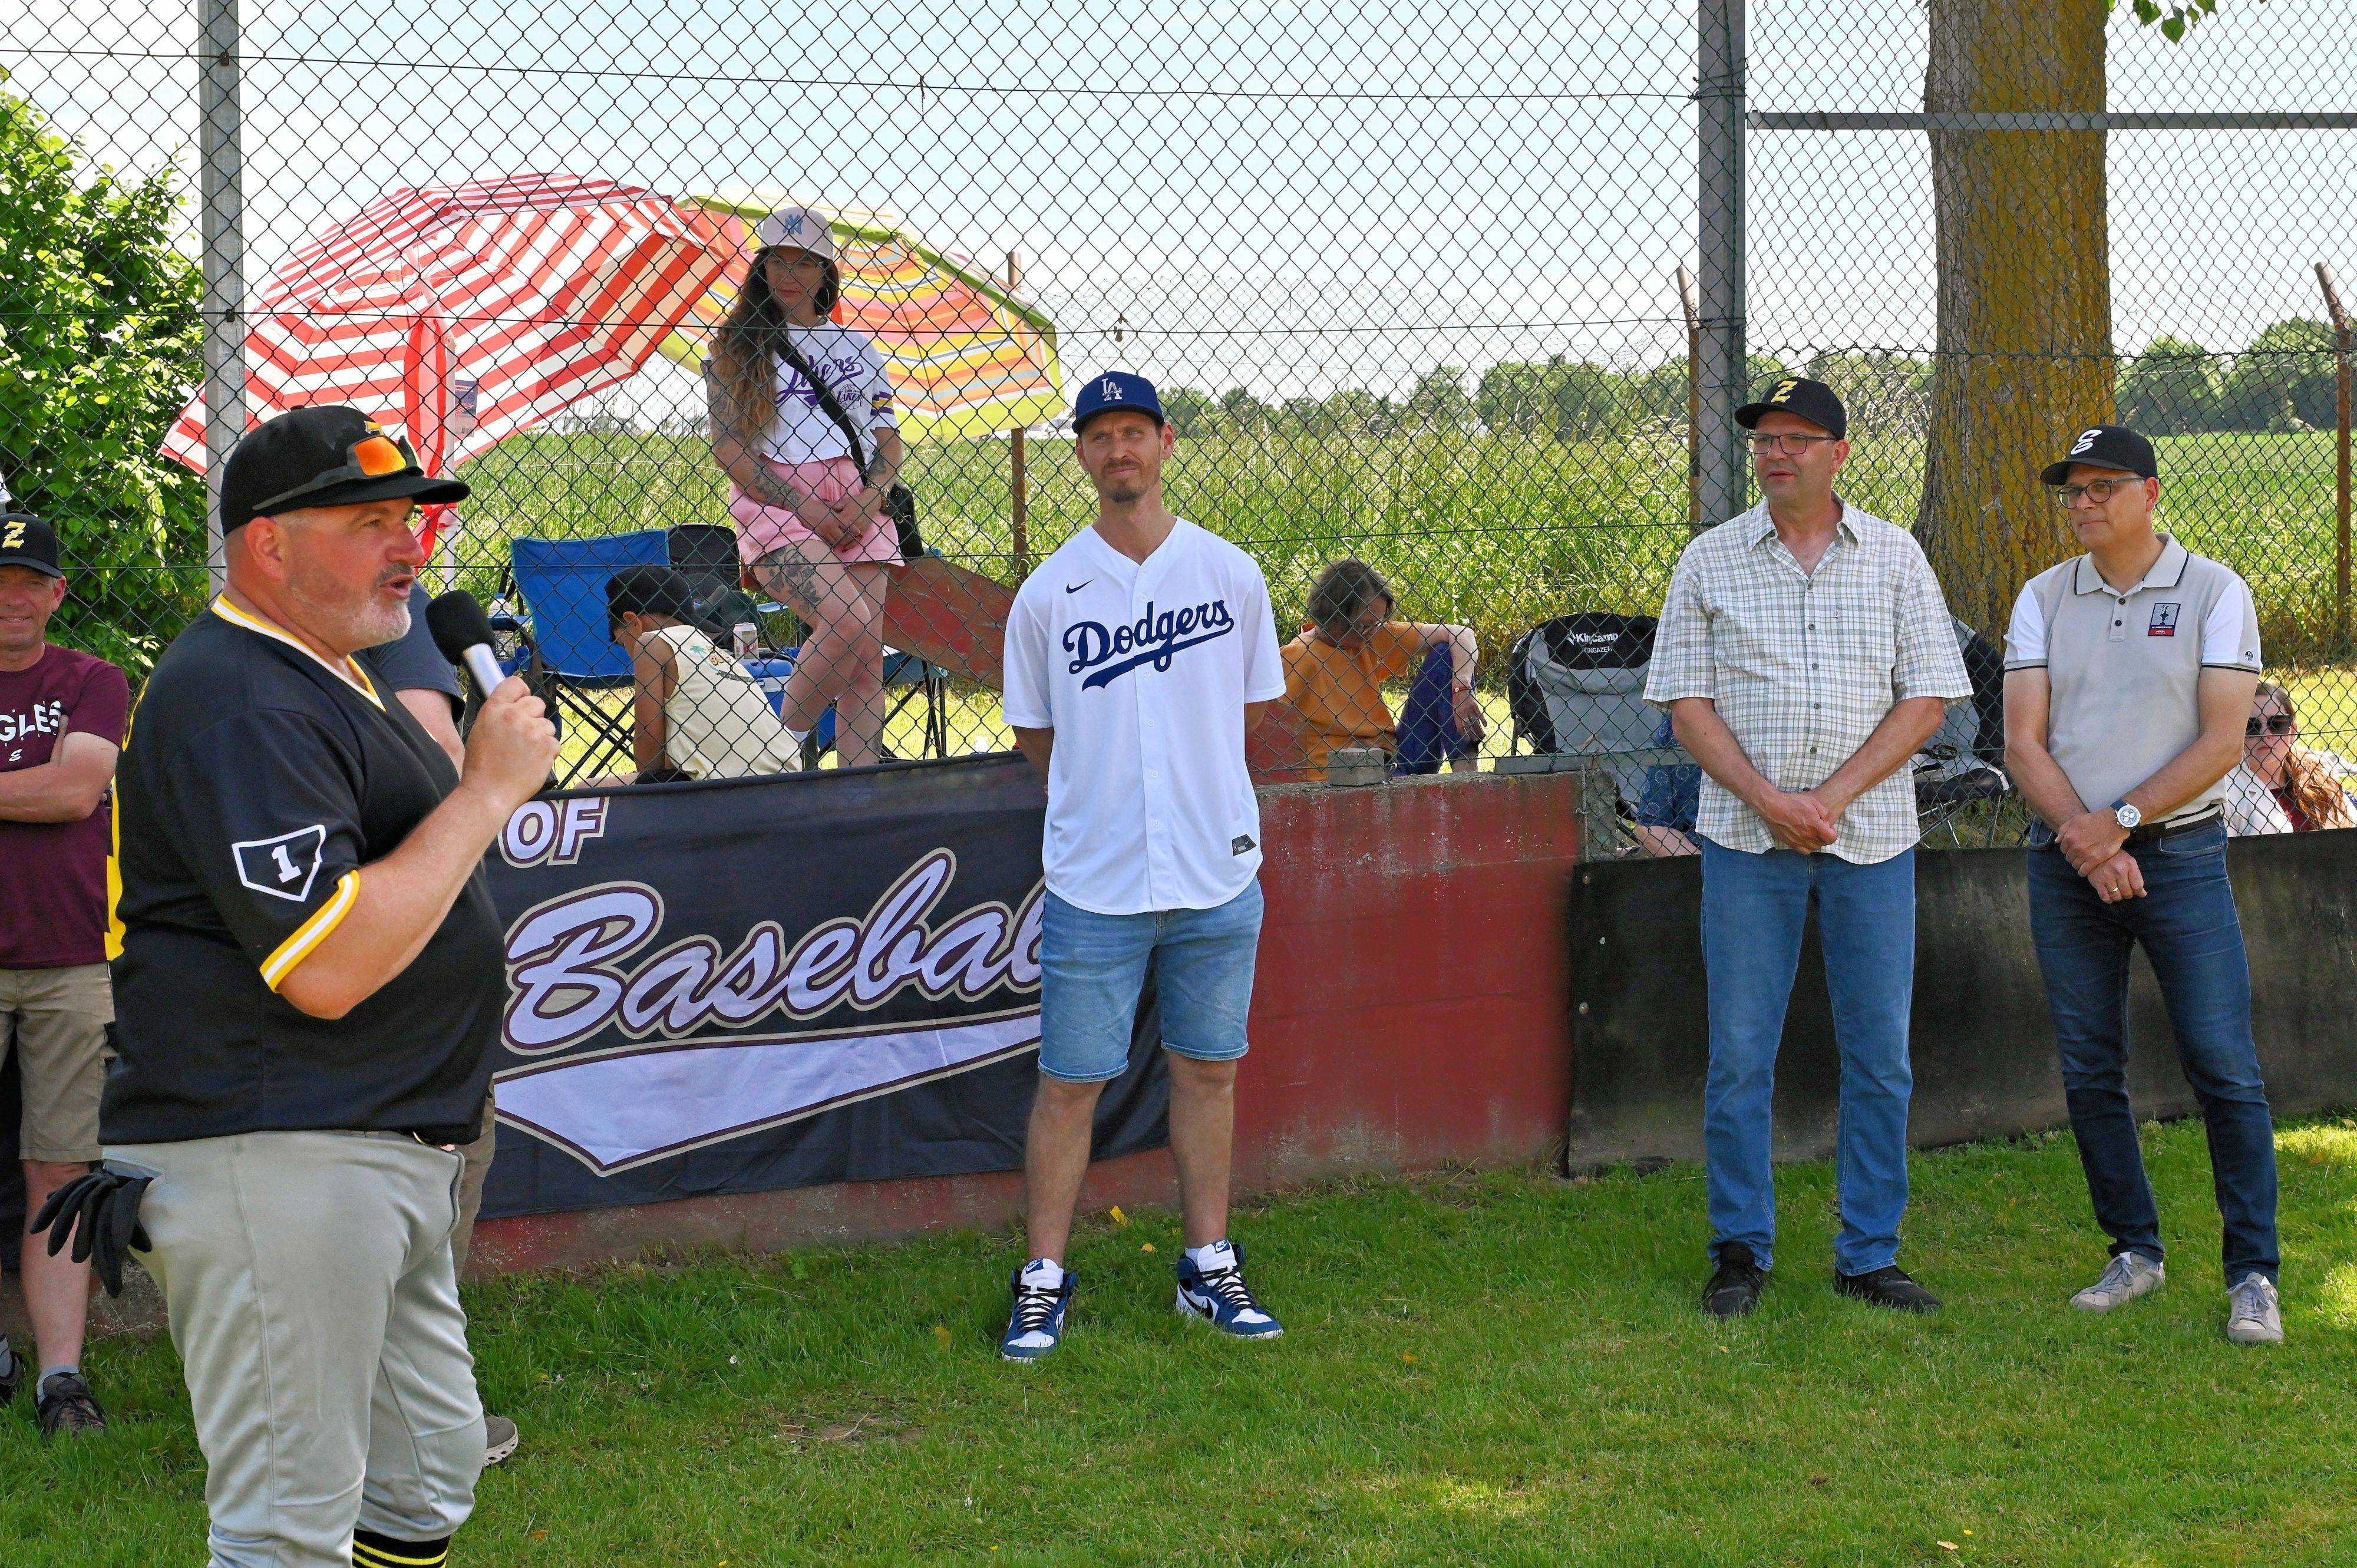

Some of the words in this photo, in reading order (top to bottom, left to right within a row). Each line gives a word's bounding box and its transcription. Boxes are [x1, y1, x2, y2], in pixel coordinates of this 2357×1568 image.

[1101, 378, 1123, 401] LA
[1771, 380, 1798, 403] Z
[2, 521, 27, 549] Z
[1062, 599, 1234, 681] Dodgers
[498, 797, 609, 867] OF
[272, 844, 302, 883] 1
